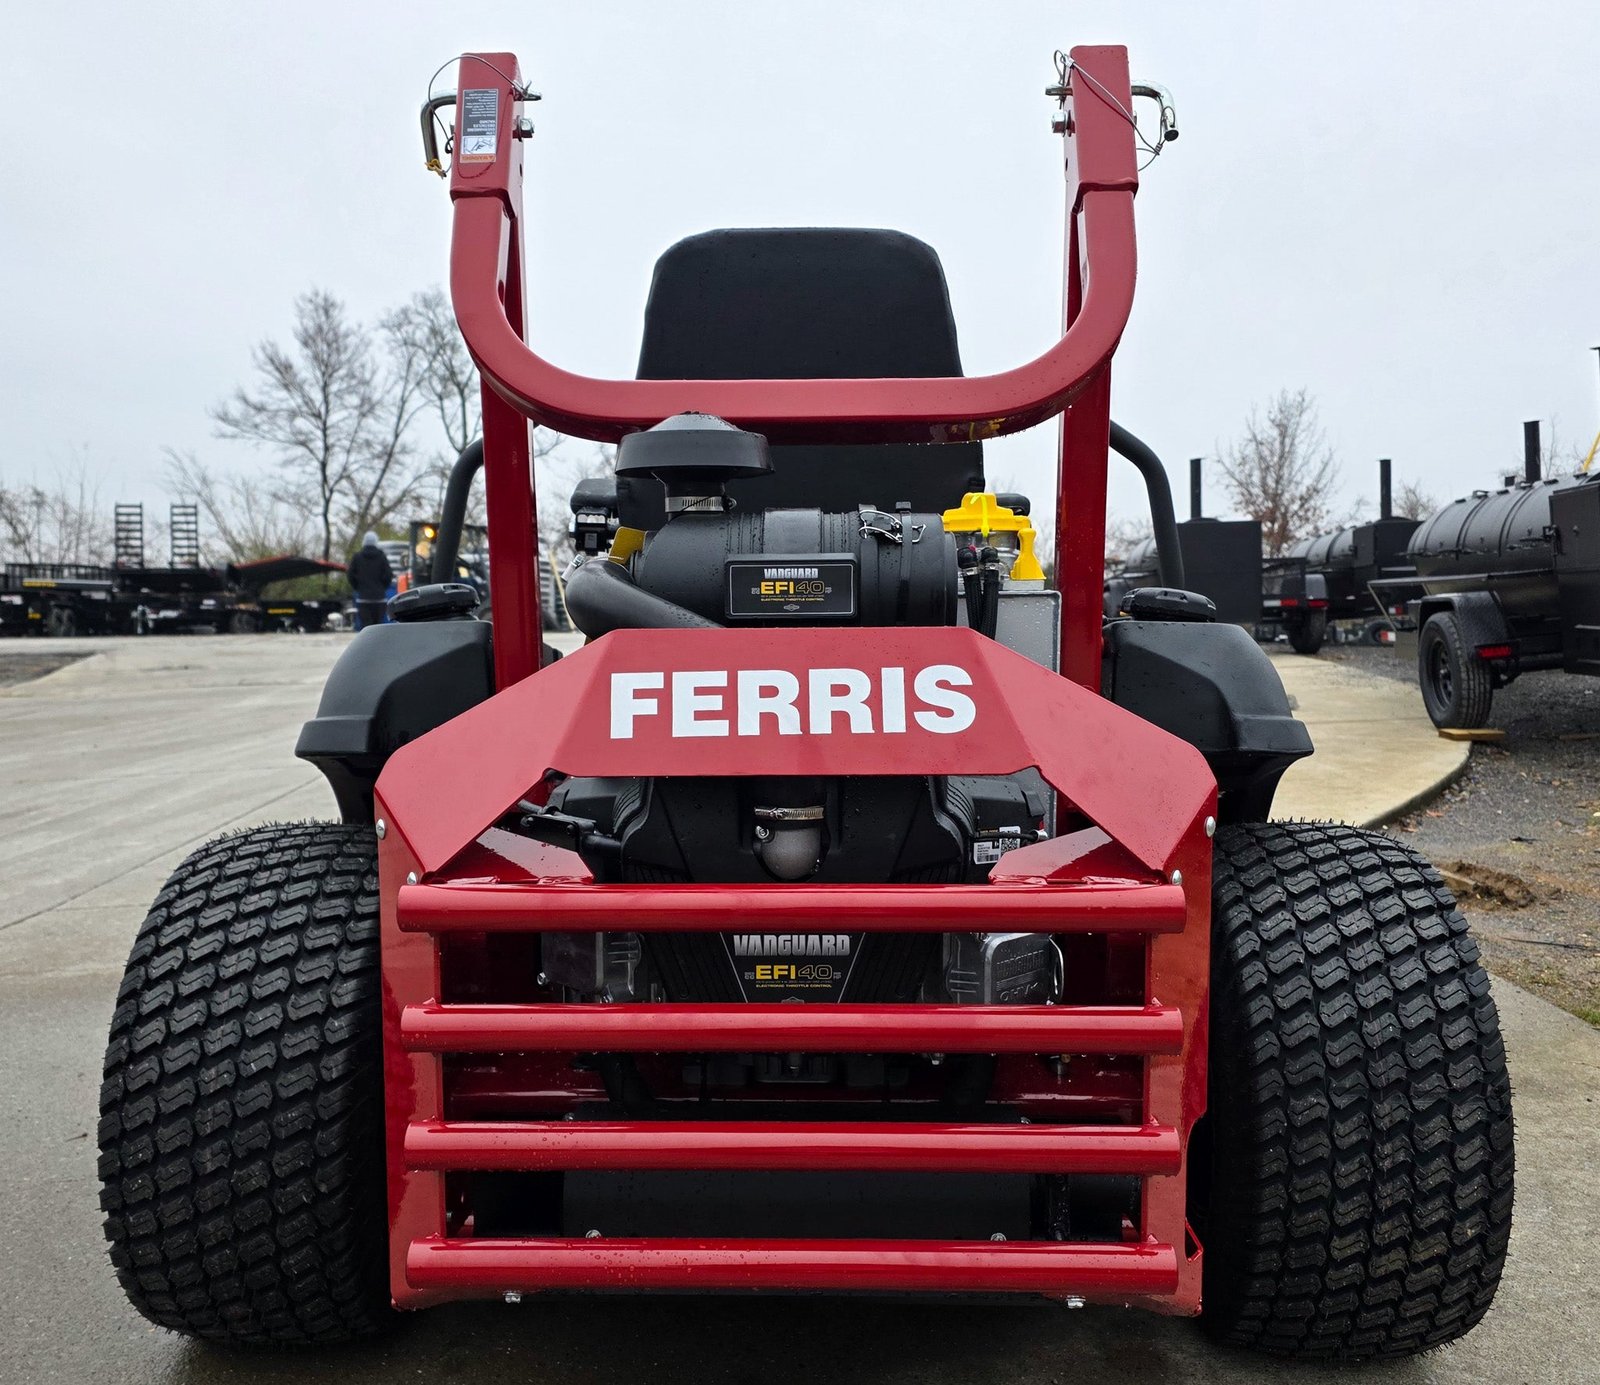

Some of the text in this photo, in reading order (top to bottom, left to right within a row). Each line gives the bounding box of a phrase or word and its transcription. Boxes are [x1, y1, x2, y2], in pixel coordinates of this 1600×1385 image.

[764, 568, 818, 579] VANGUARD
[610, 664, 977, 739] FERRIS
[733, 934, 851, 956] VANGUARD
